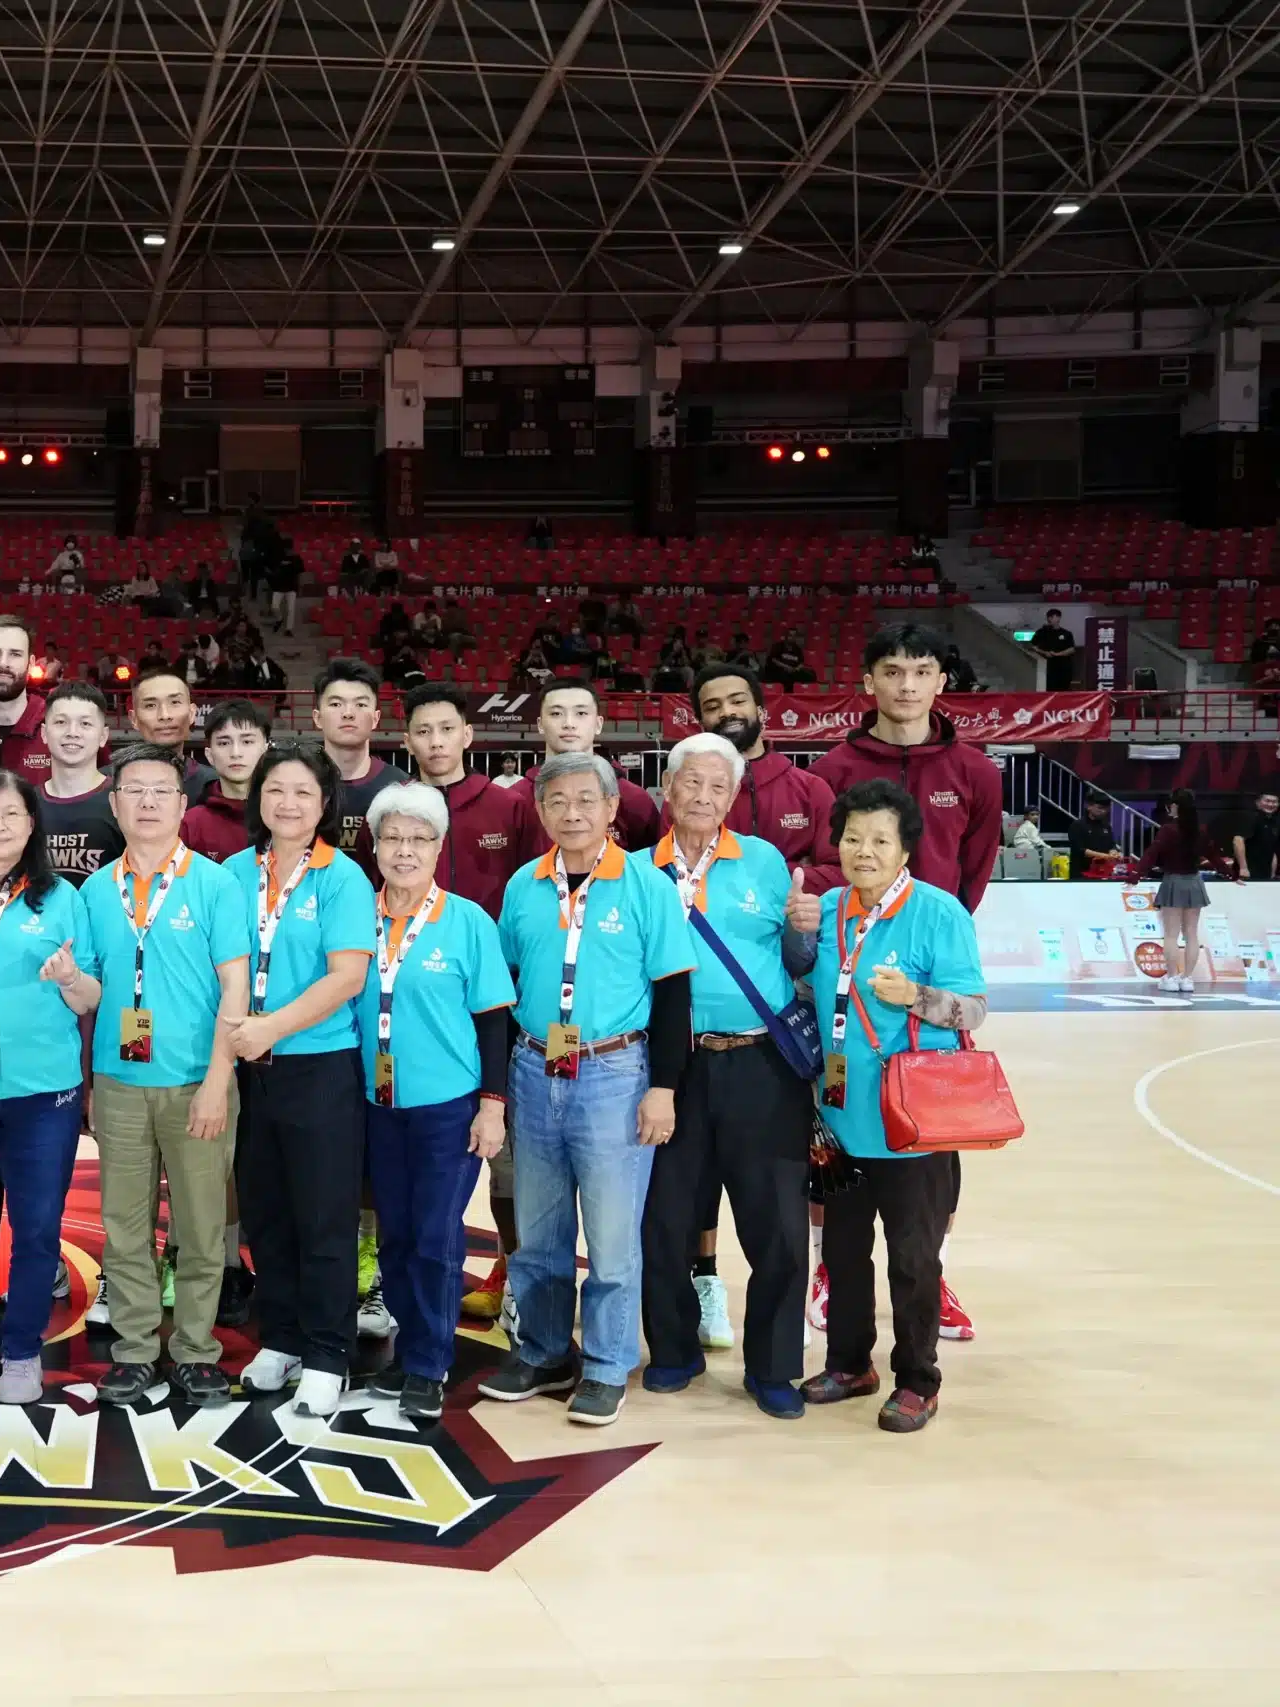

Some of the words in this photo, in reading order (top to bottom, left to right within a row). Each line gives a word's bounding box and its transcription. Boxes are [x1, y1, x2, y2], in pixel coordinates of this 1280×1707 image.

[491, 714, 523, 722] Hyperice
[809, 712, 863, 727] NCKU
[1043, 709, 1099, 724] NCKU
[24, 758, 51, 766] HAWKS
[930, 796, 959, 804] HAWKS
[780, 817, 809, 827] HAWKS
[46, 834, 88, 847] HOST
[477, 837, 508, 847] HAWKS
